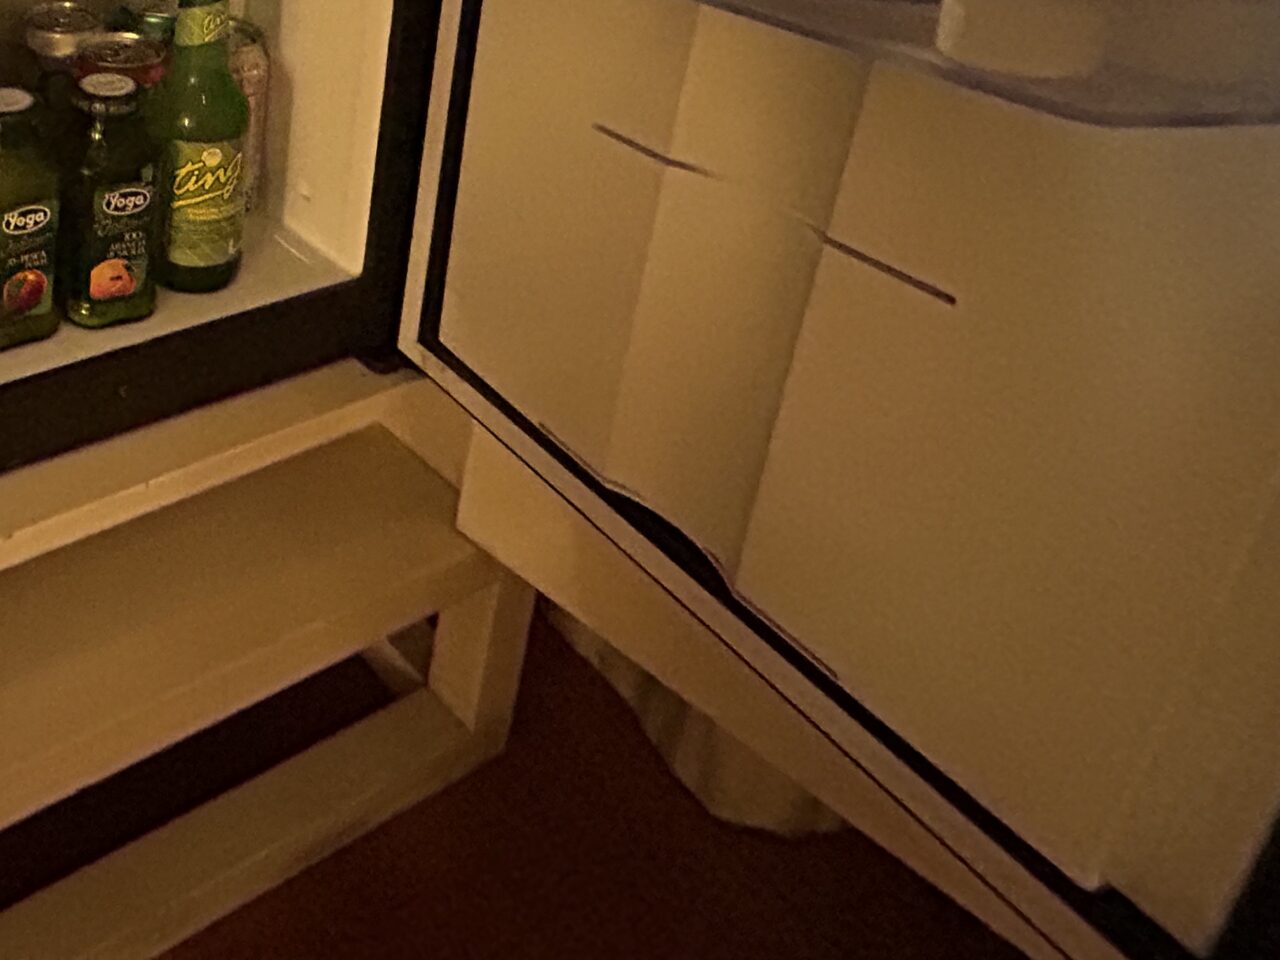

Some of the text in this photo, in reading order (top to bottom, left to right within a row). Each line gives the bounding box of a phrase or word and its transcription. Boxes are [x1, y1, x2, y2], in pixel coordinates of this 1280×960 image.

[172, 151, 243, 200] ting
[104, 192, 145, 212] Yoga
[4, 211, 45, 231] Yoga
